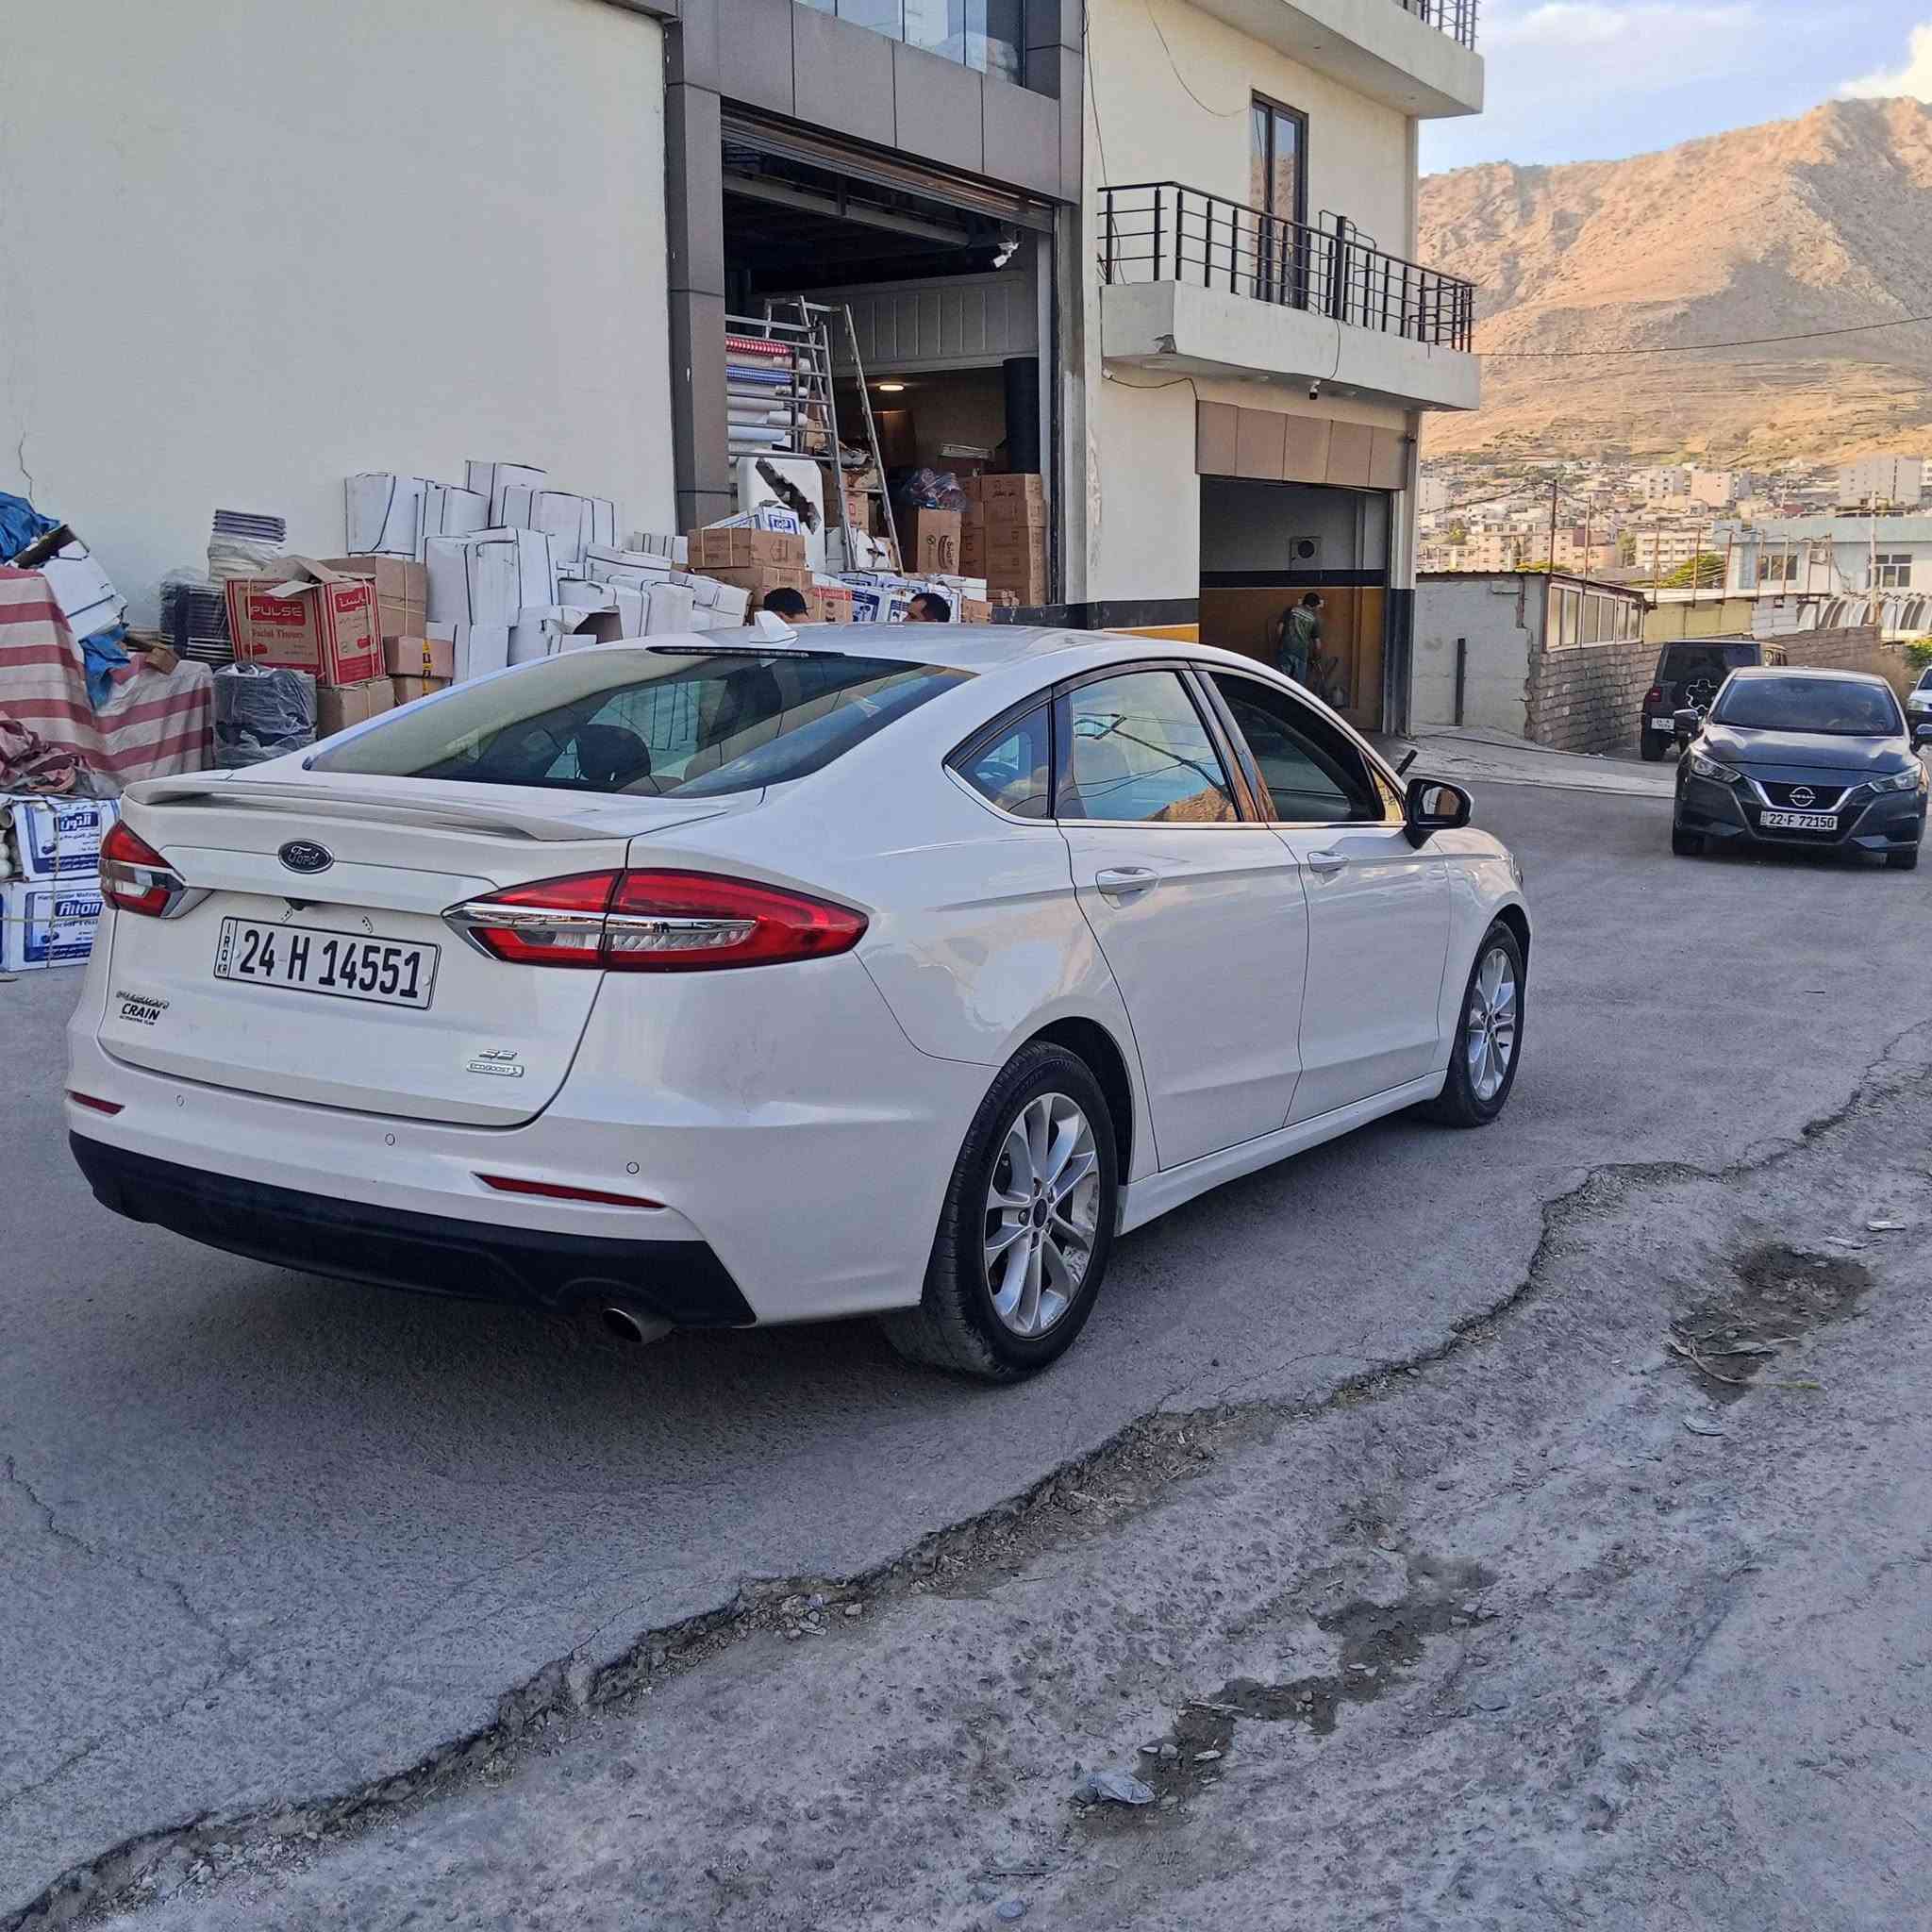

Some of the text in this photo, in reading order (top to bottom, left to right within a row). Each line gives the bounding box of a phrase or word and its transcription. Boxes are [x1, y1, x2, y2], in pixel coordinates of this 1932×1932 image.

[250, 604, 303, 617] PULSE
[240, 929, 421, 999] 24 H 14551
[122, 1003, 160, 1021] CRAIN
